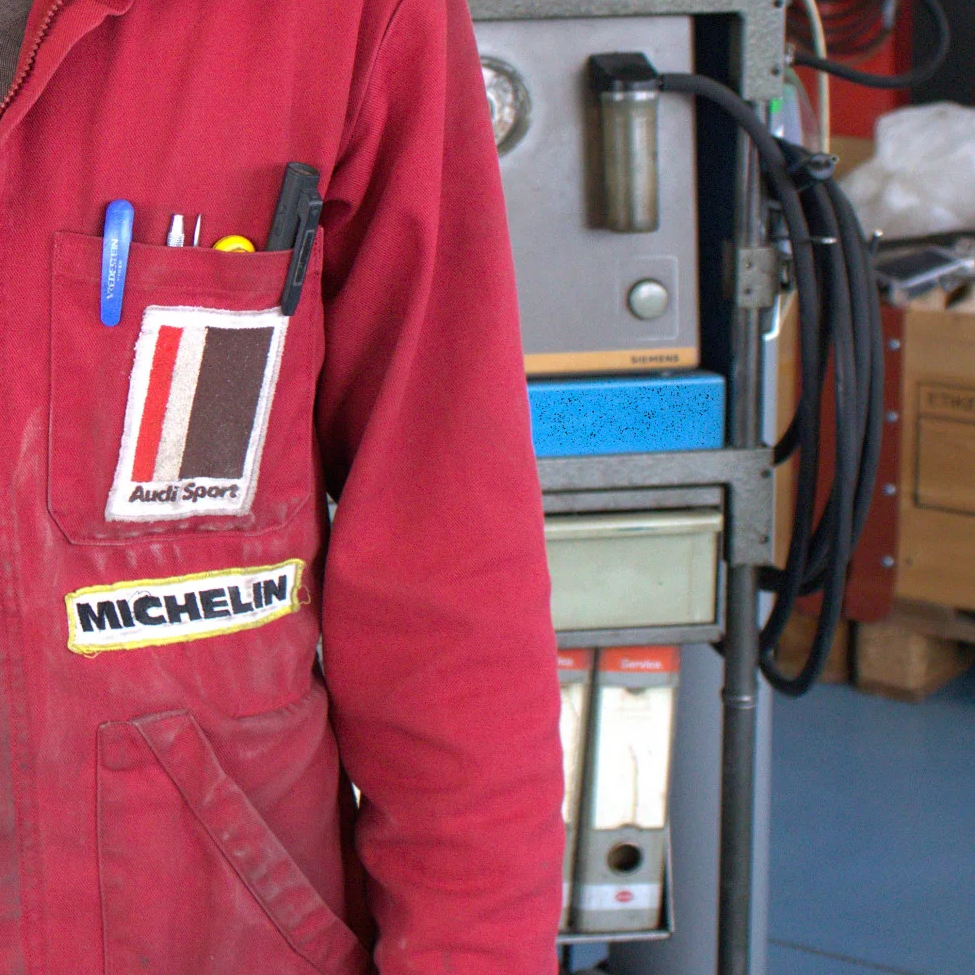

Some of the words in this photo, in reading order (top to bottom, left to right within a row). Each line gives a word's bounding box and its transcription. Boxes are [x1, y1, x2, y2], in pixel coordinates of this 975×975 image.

[128, 485, 180, 503] Audi
[182, 482, 240, 503] Sport
[76, 575, 287, 633] MICHELIN
